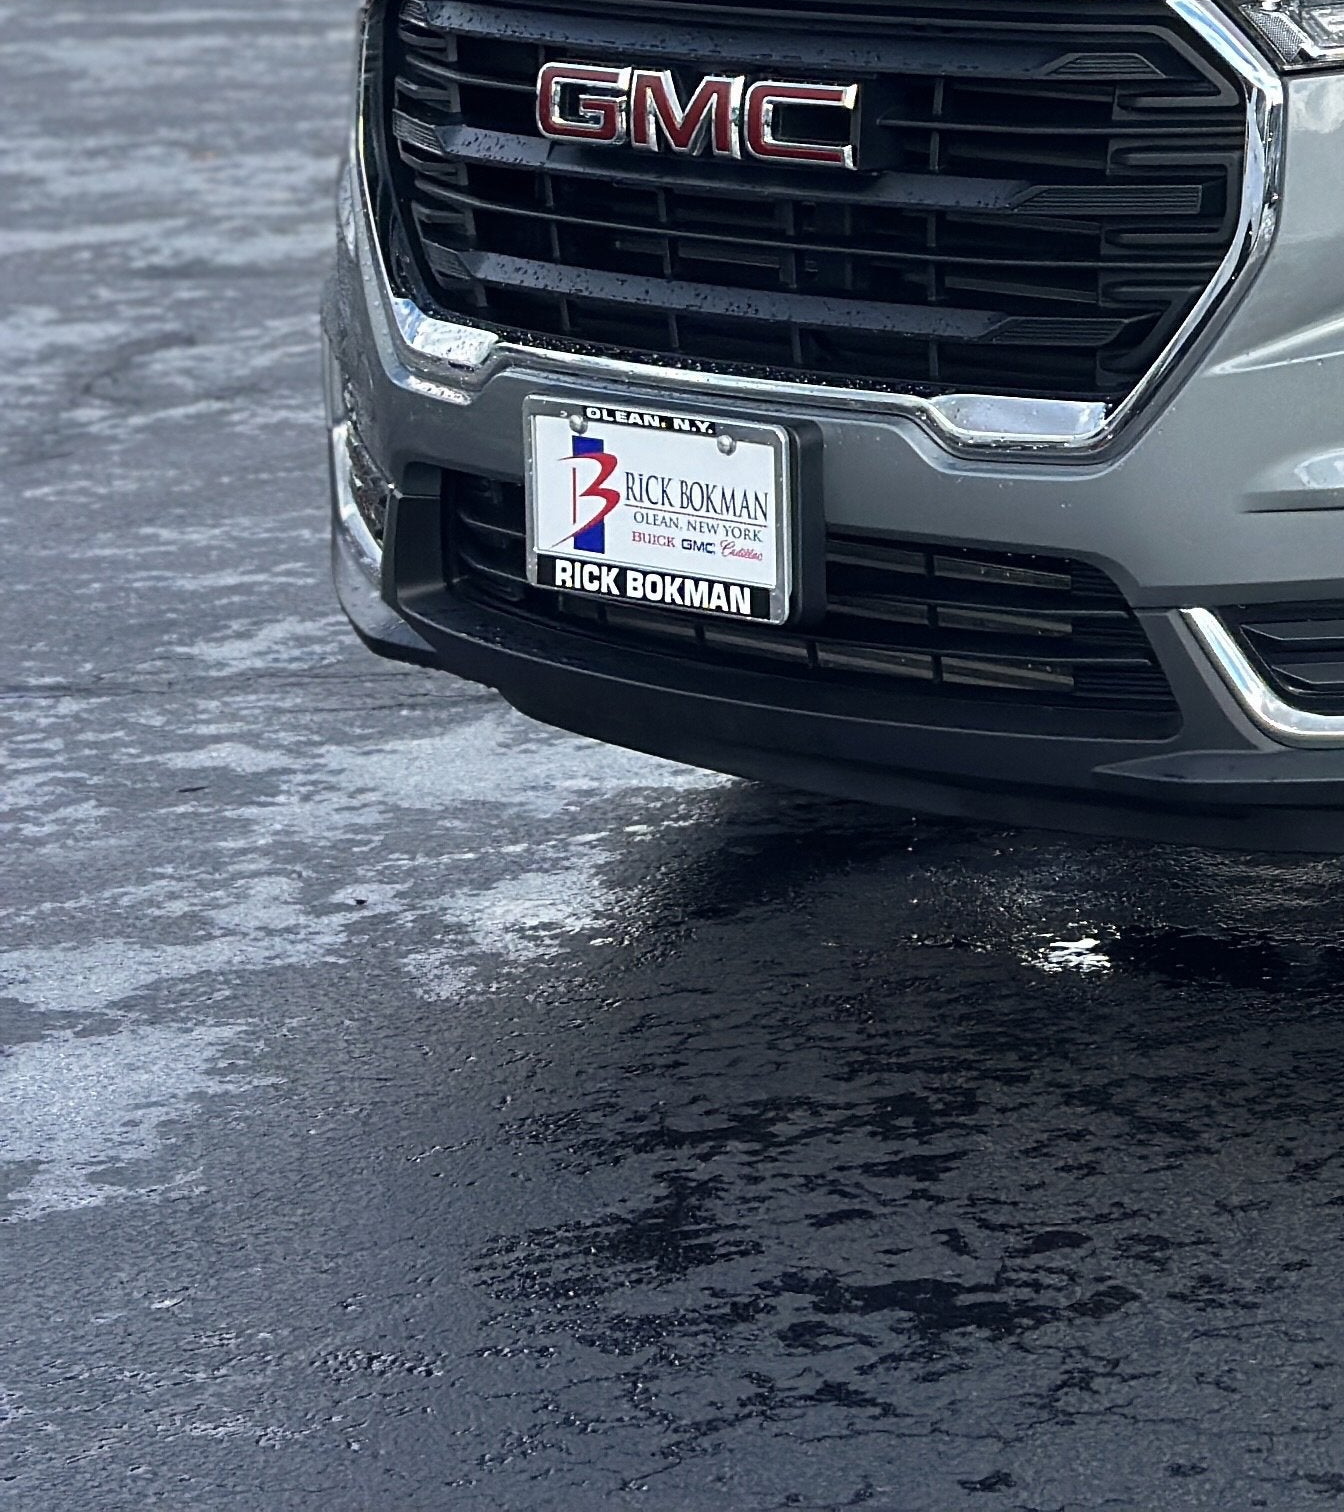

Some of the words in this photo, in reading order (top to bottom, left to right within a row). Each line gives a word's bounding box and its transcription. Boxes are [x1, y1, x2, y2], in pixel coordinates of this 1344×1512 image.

[537, 61, 858, 171] GMC
[673, 417, 714, 434] N.Y.
[679, 479, 769, 522] BOKMAN
[631, 531, 677, 549] BUICK
[681, 538, 717, 556] GMC
[719, 539, 764, 563] Cadillac
[686, 519, 721, 535] NEW
[722, 524, 764, 543] YORK
[555, 558, 621, 596] RICK
[625, 569, 752, 616] BOKMAN
